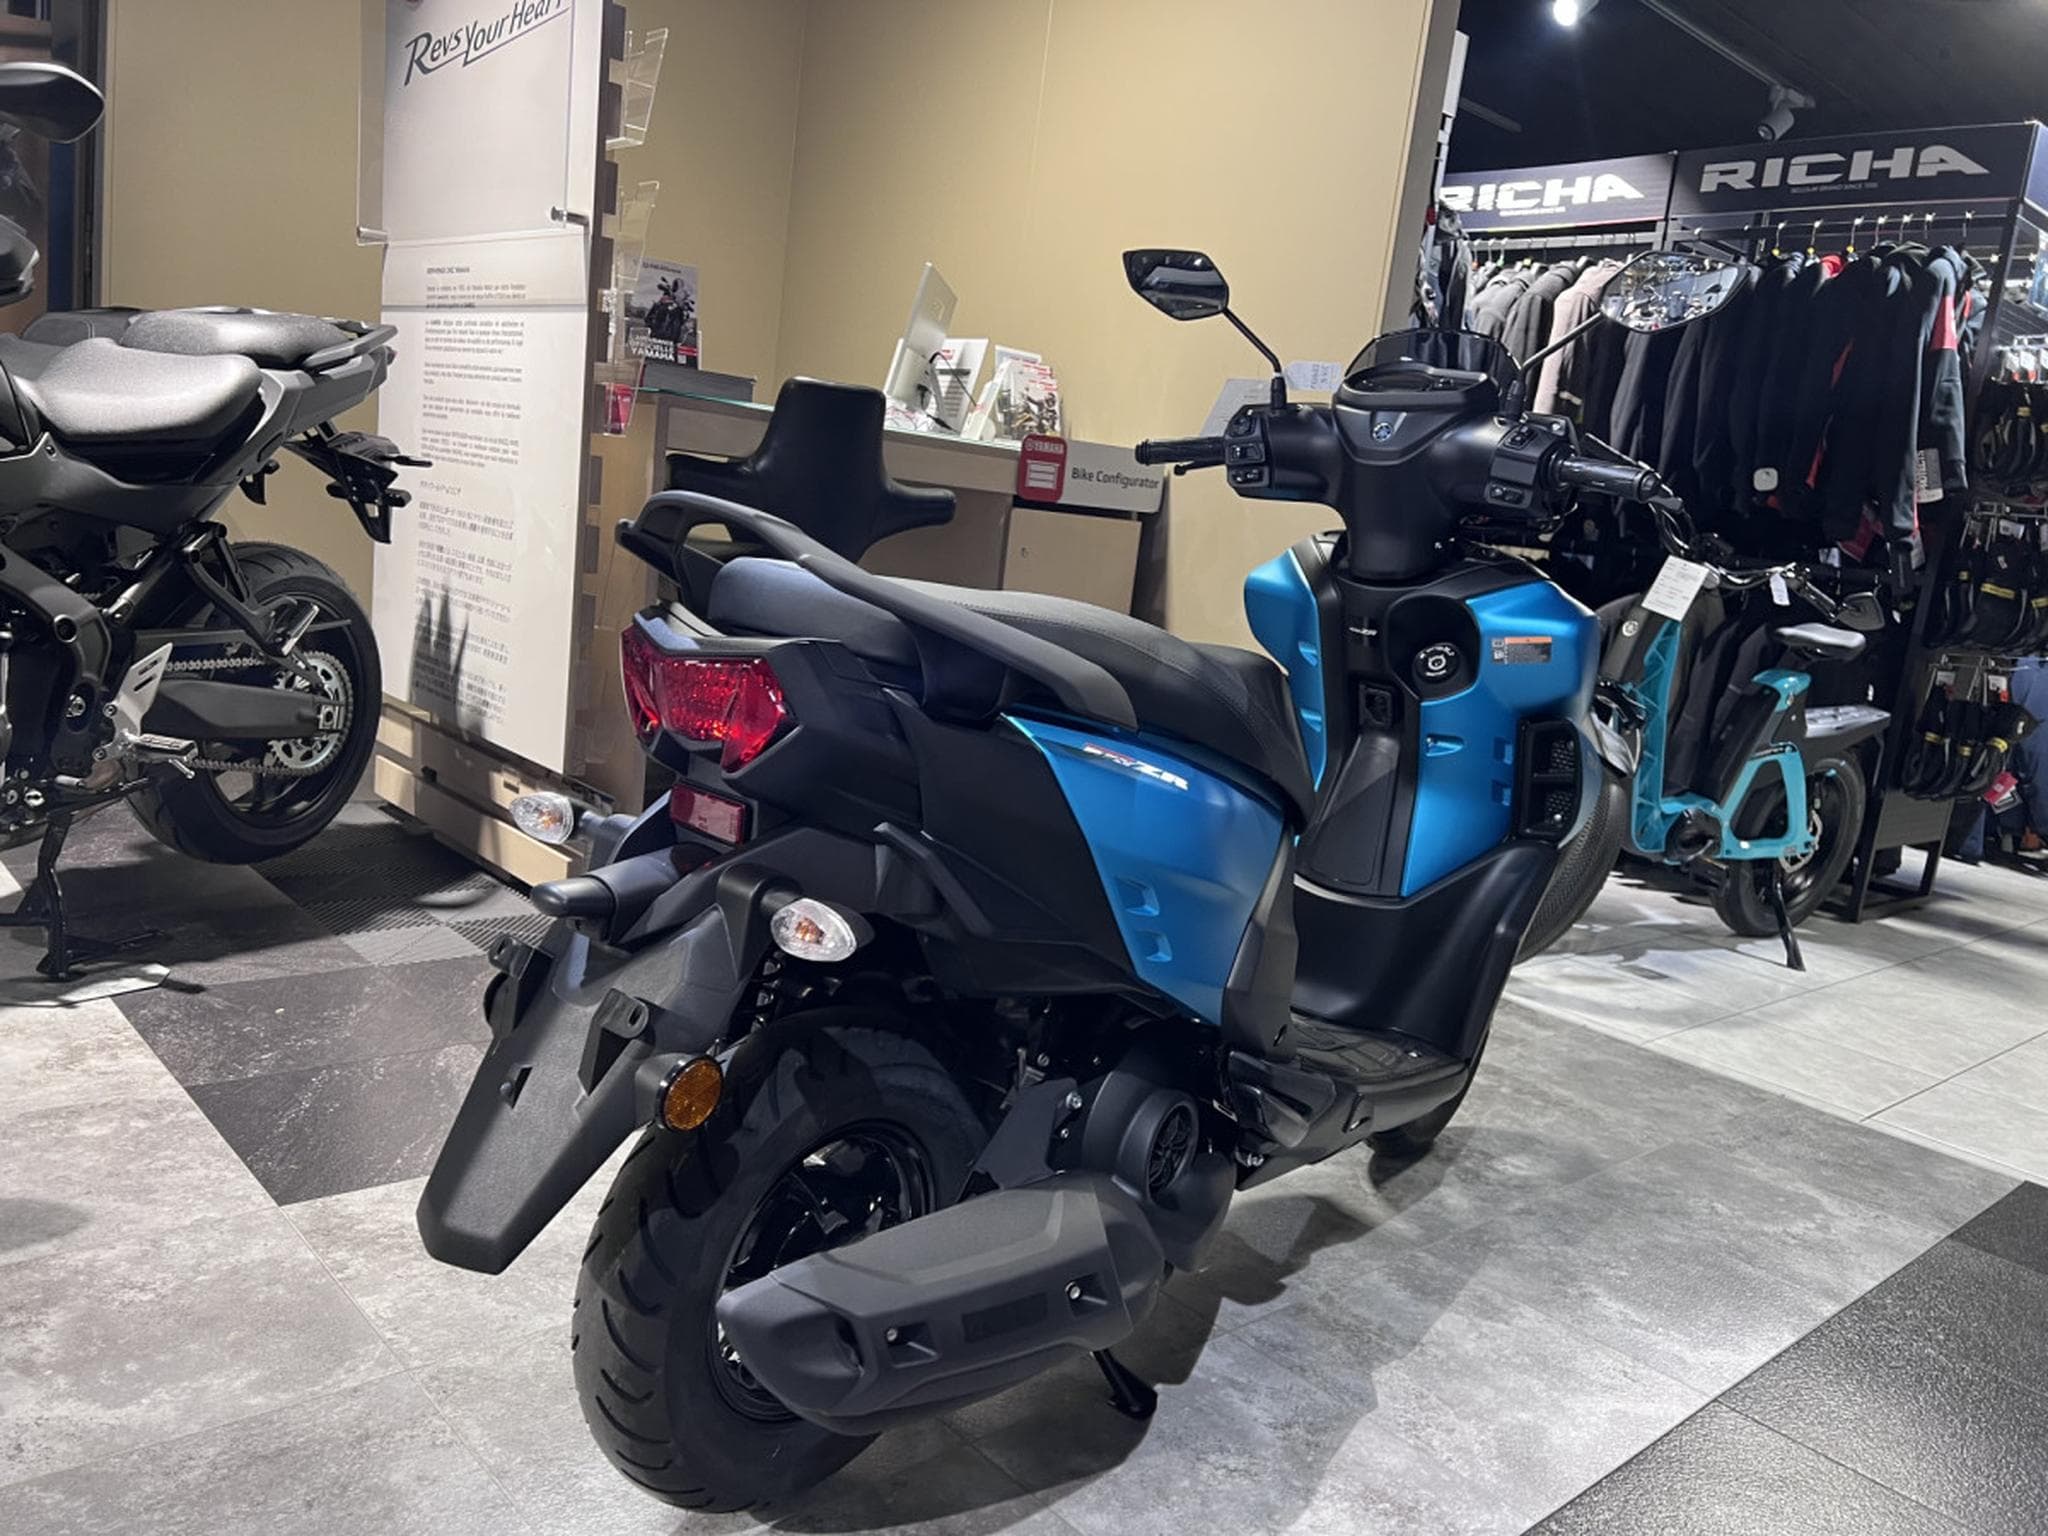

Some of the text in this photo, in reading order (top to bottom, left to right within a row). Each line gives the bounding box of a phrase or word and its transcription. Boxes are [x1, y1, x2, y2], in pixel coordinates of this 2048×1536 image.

[404, 28, 464, 86] Revs
[462, 15, 510, 67] Your
[1699, 145, 1991, 193] RICHA
[1439, 173, 1645, 212] RICHA
[631, 347, 675, 361] YAMAHA
[1071, 467, 1160, 489] Bike Configurator
